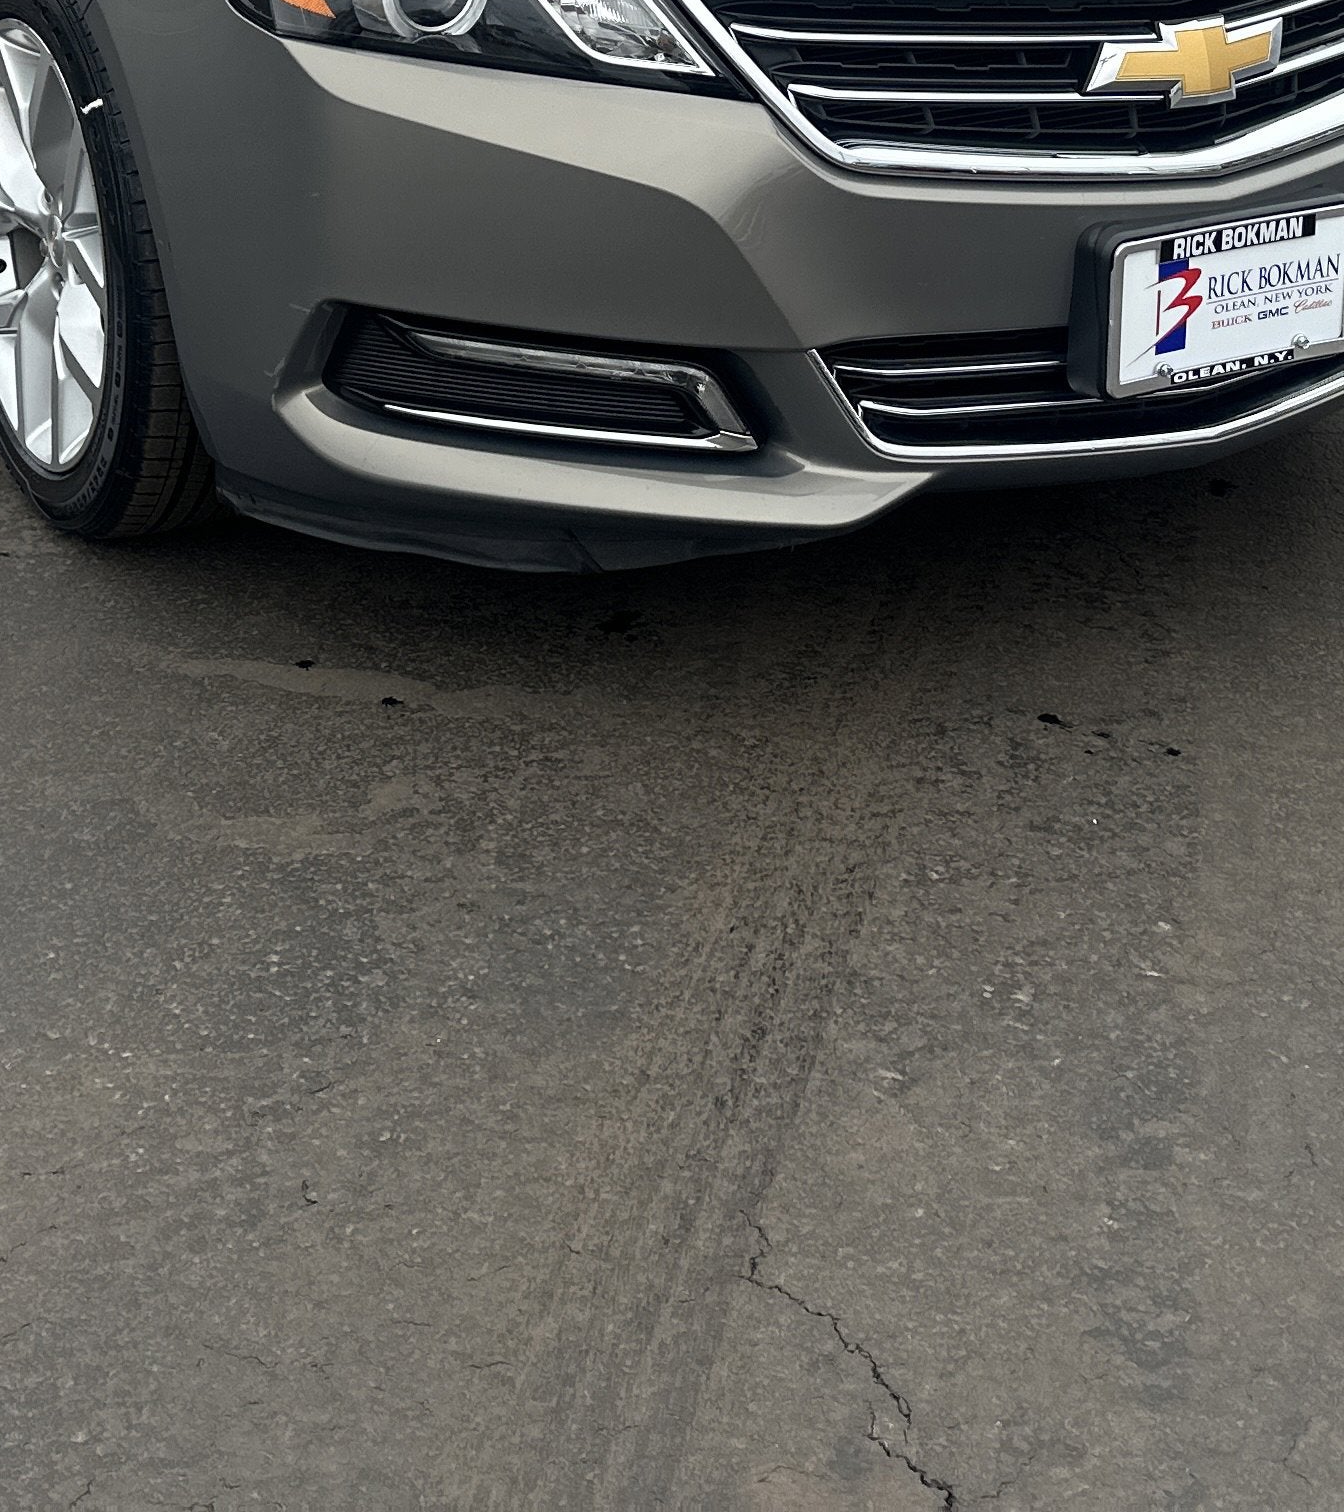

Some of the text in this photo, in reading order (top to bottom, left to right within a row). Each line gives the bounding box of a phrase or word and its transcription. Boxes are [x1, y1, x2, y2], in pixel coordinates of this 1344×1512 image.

[1172, 216, 1304, 260] RICK BOKMAN
[1207, 253, 1340, 300] RICK BOKMAN
[1263, 290, 1294, 306] NEW
[1296, 283, 1334, 299] YORK
[1211, 314, 1254, 329] BUICK
[1257, 306, 1289, 320] GMC
[1173, 351, 1293, 383] OLEAN, N.Y.
